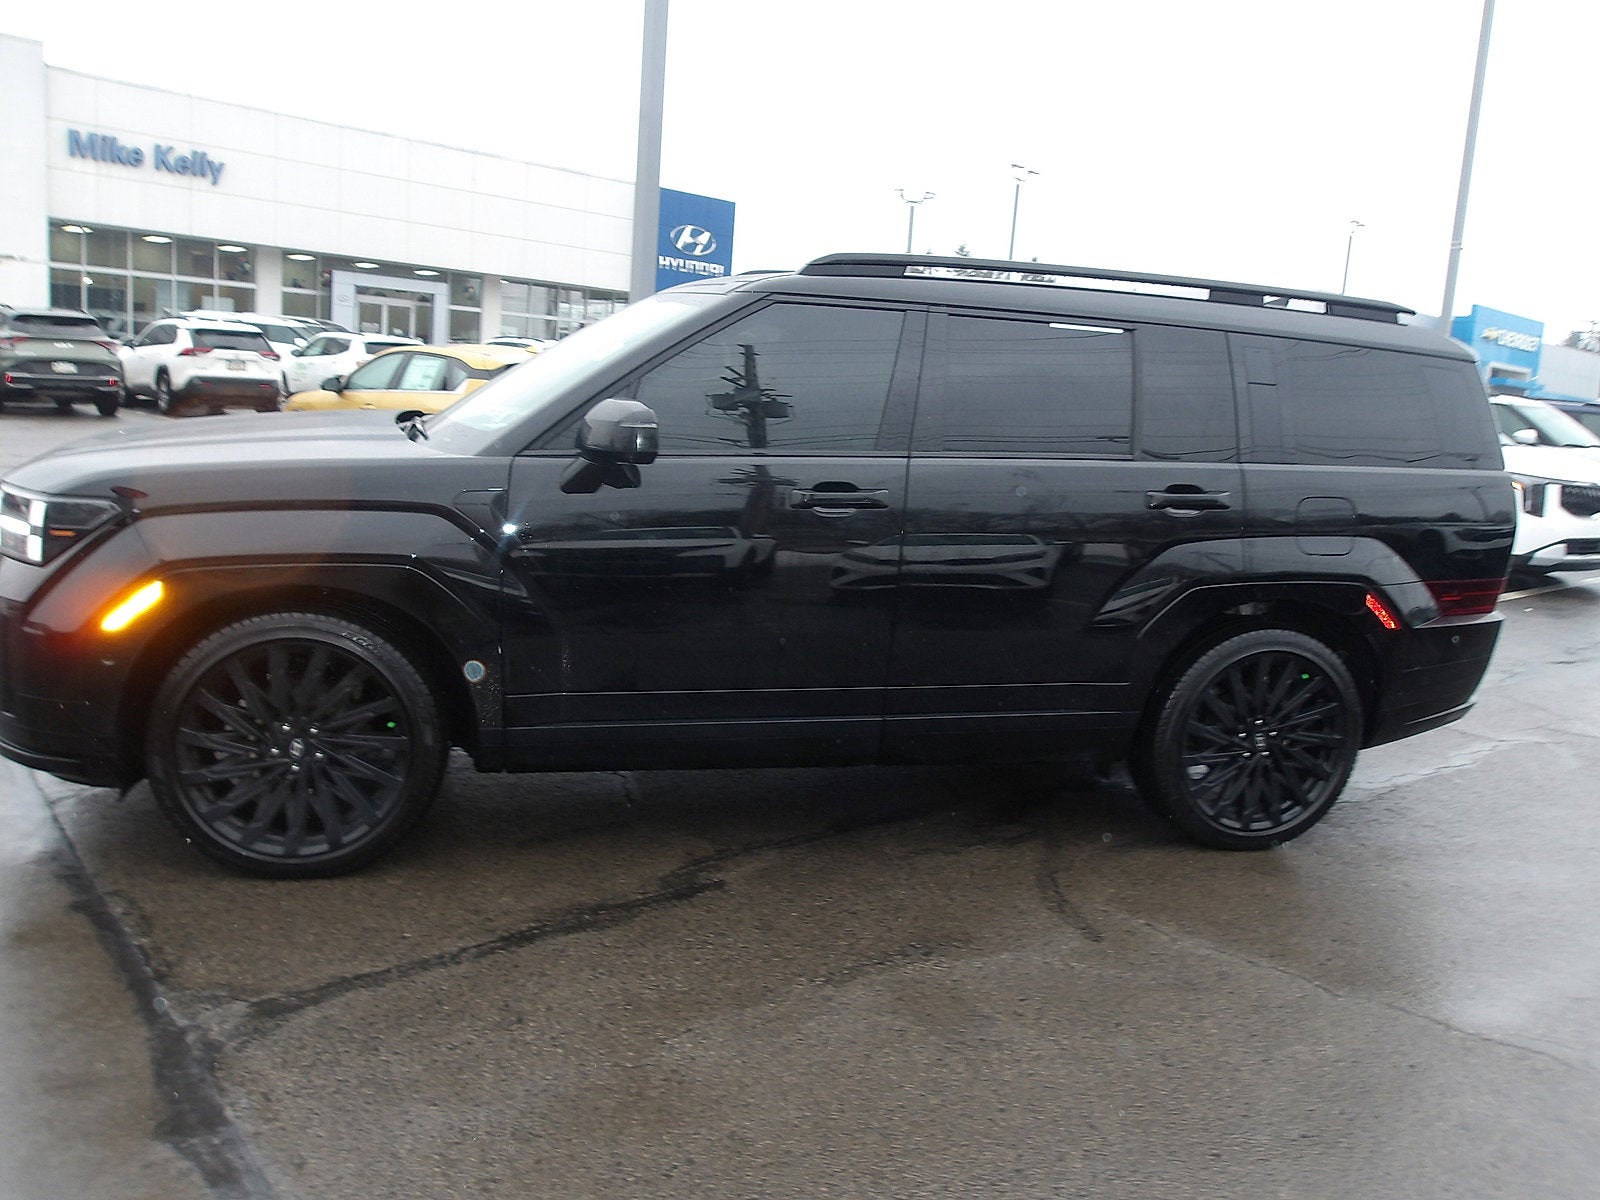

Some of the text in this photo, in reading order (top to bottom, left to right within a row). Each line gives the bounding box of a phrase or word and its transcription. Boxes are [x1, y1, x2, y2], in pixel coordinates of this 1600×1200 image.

[69, 129, 225, 185] Mike Kelly
[658, 255, 725, 276] HYUNDAI
